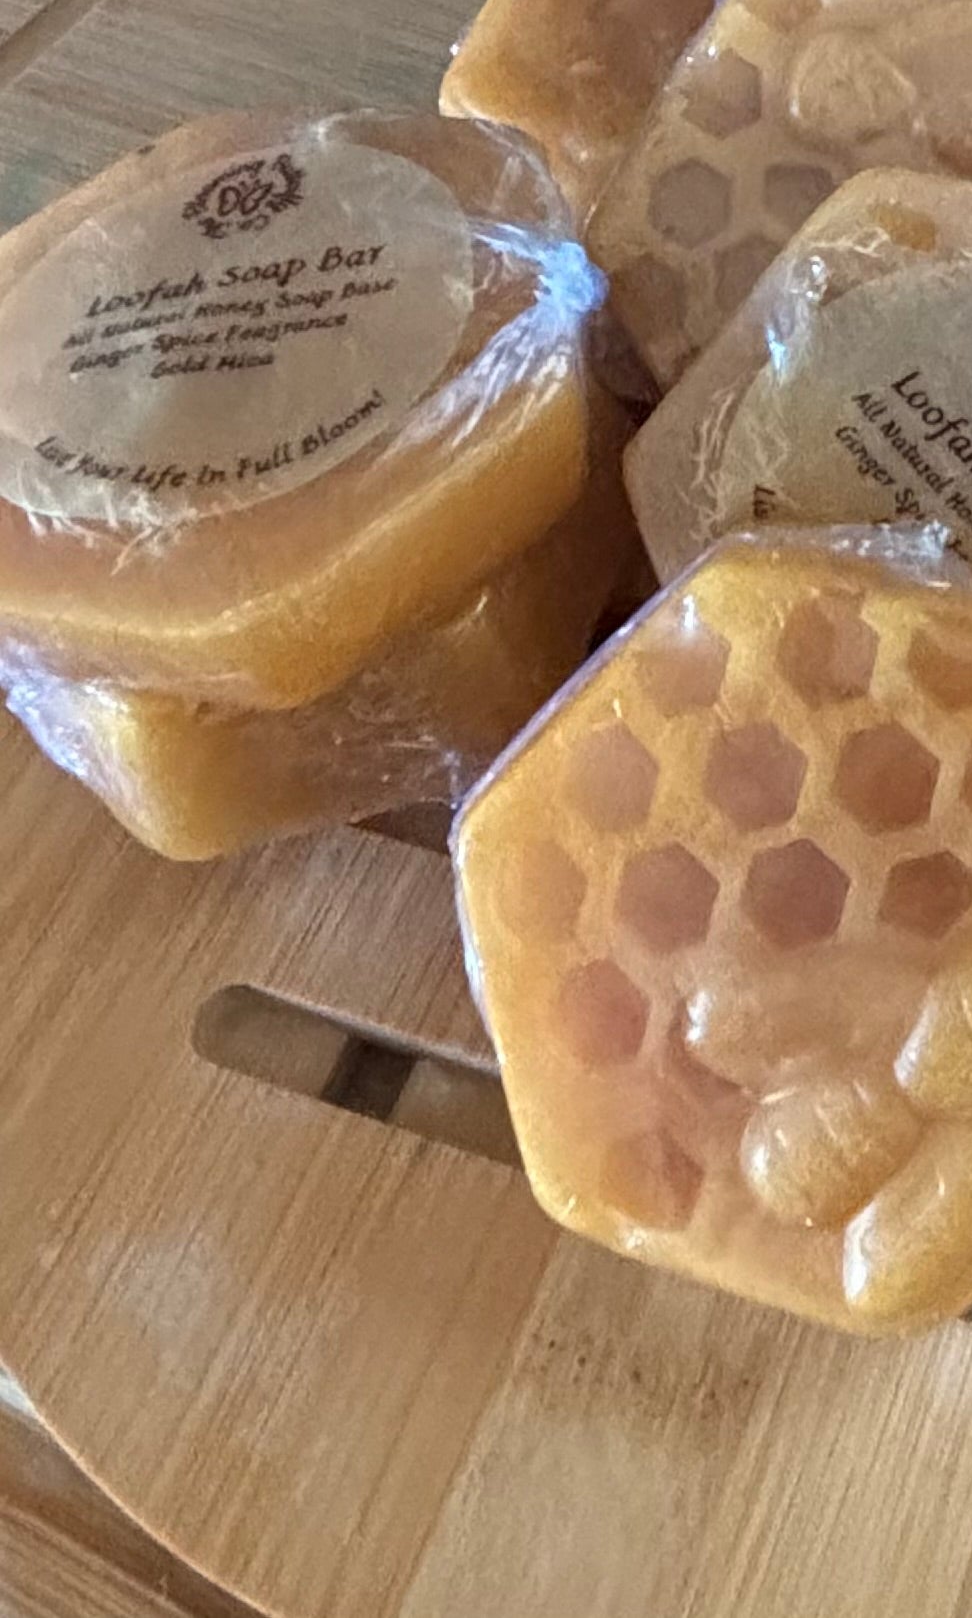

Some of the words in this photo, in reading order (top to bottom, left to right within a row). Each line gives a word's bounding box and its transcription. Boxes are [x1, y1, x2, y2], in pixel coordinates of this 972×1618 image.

[86, 269, 206, 318] Loofah
[216, 257, 307, 288] Soap
[317, 242, 388, 273] Bar
[130, 464, 188, 493] Life
[196, 463, 227, 487] In
[235, 441, 294, 480] Full
[835, 424, 898, 487] Ginger
[851, 390, 888, 423] All
[879, 418, 955, 495] Natural
